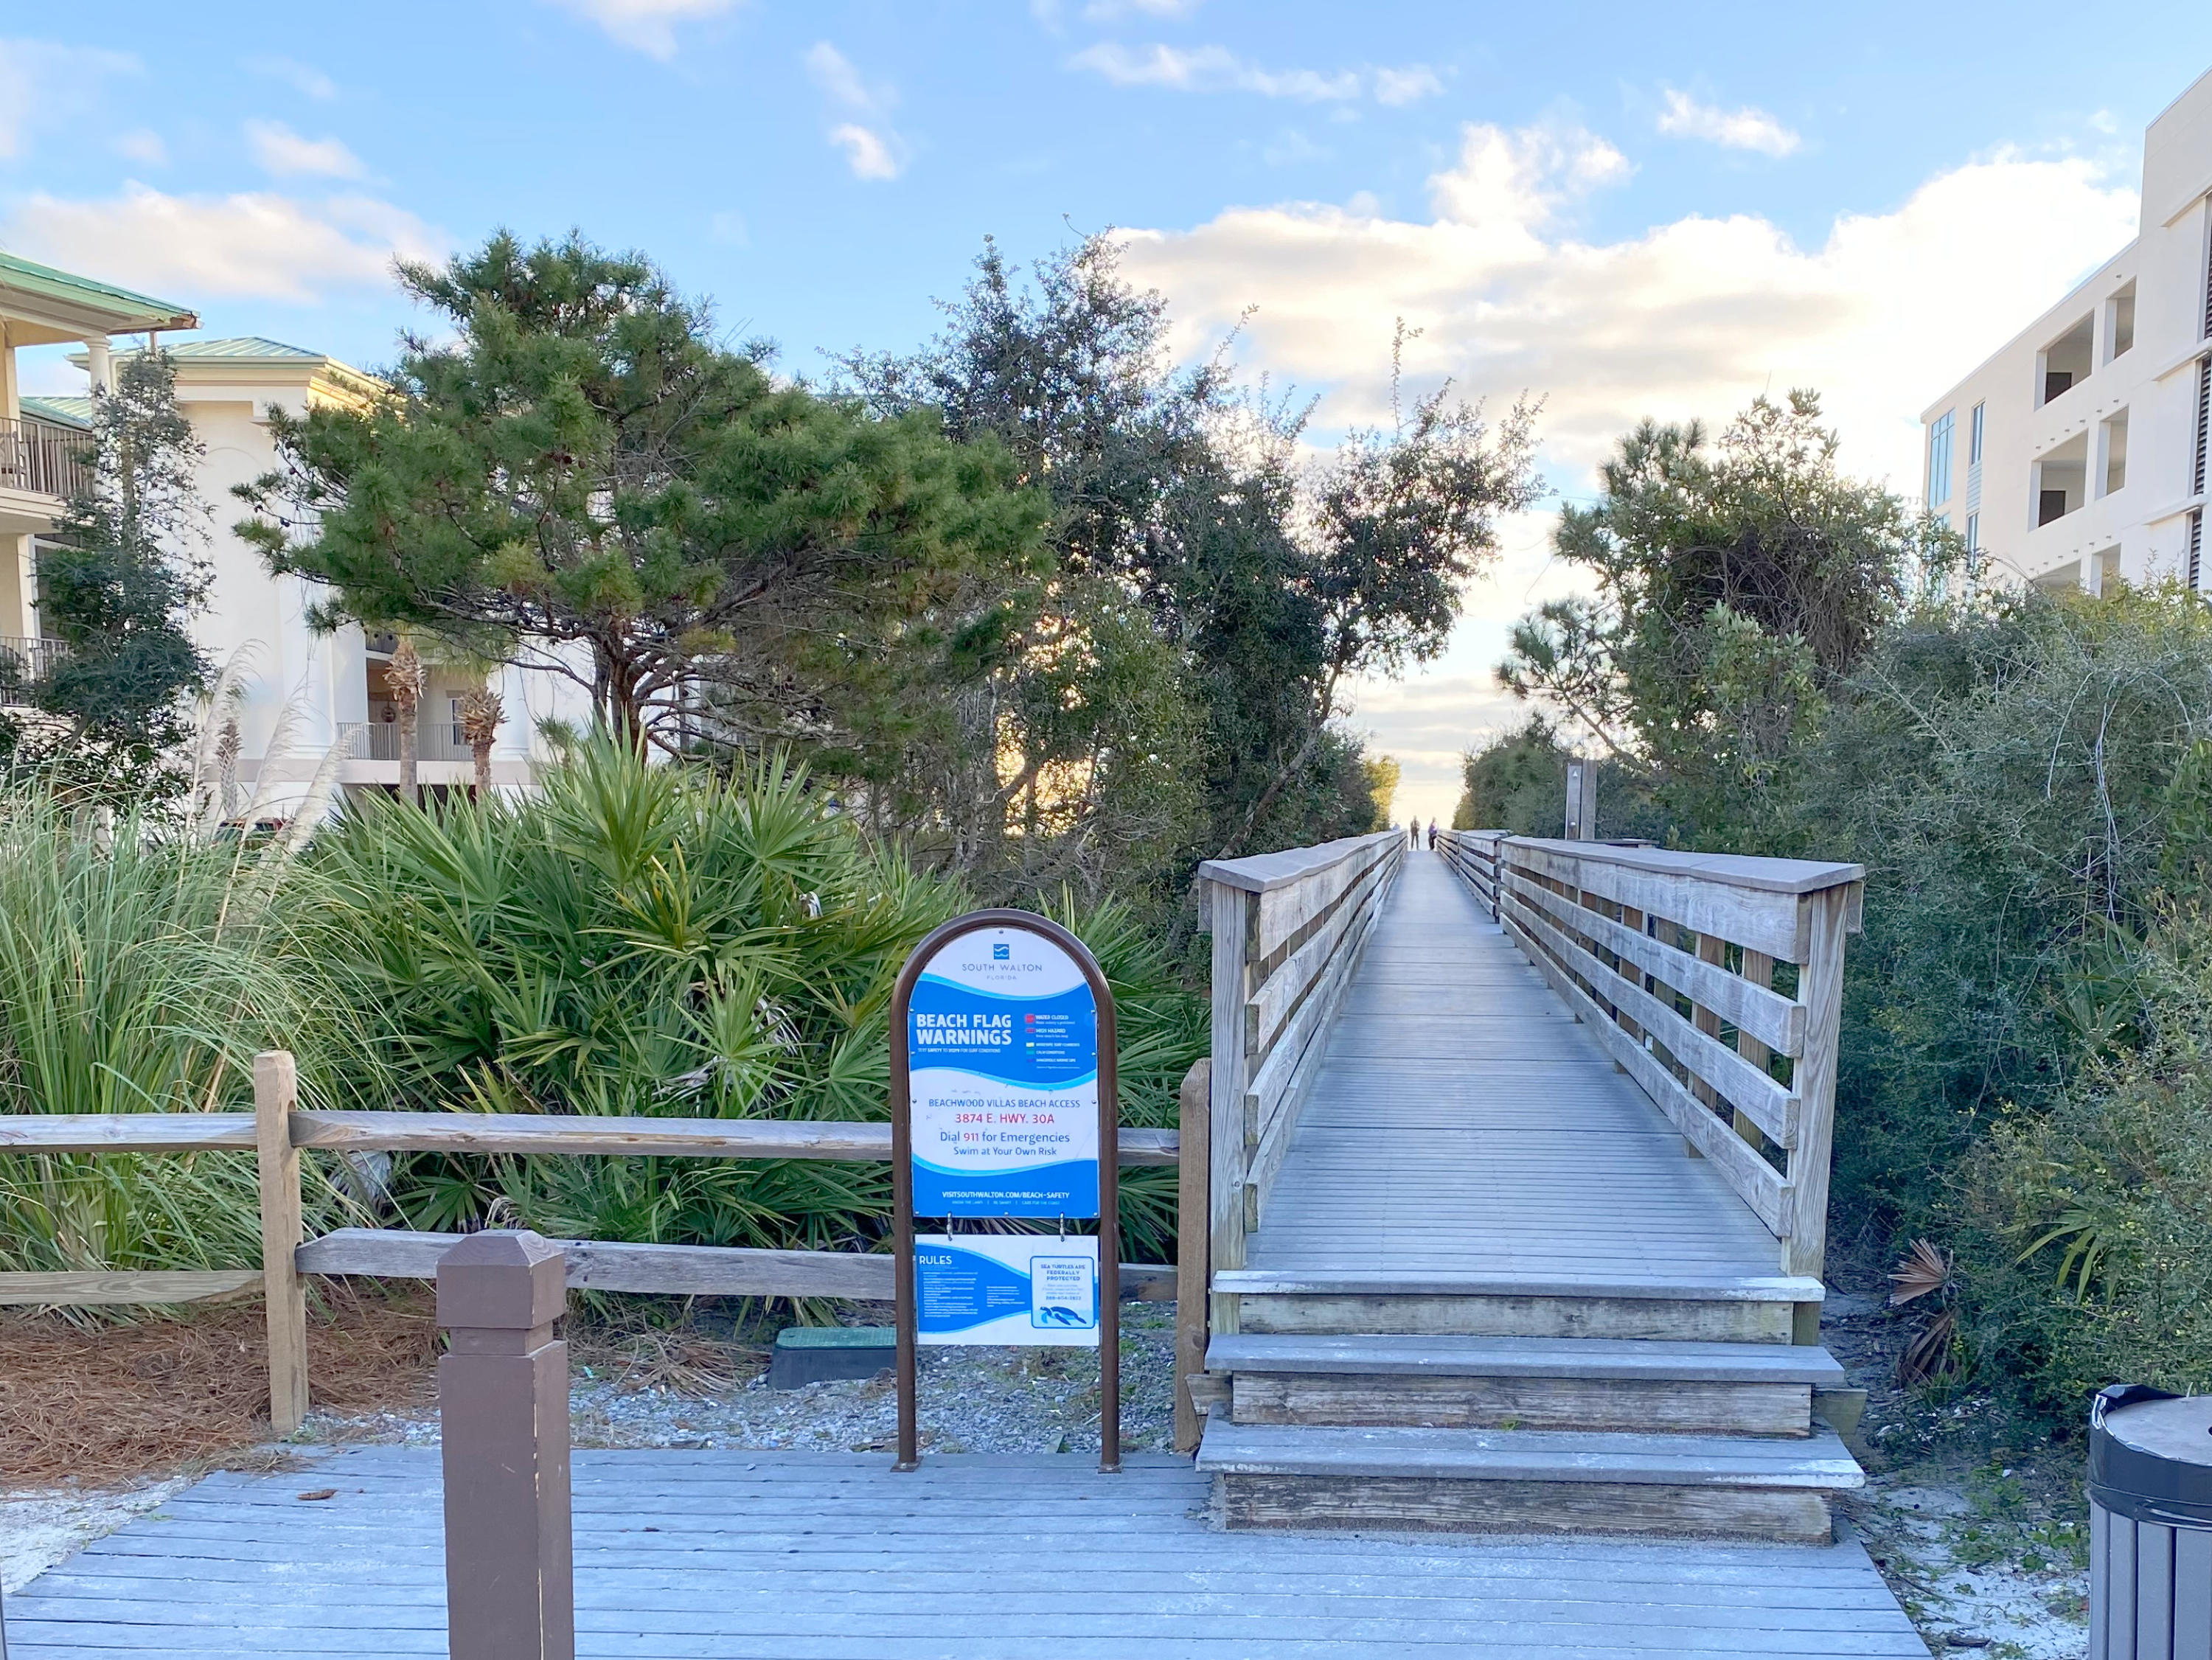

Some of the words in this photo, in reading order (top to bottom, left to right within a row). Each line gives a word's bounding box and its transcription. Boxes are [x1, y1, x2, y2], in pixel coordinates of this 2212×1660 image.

[961, 963, 995, 972] SOUTH
[1000, 963, 1043, 972] WALTON
[917, 1014, 967, 1028] BEACH
[973, 1014, 1012, 1028] FLAG
[916, 1029, 1012, 1046] WARNINGS
[928, 1099, 984, 1108] BEACHWOOD
[987, 1099, 1016, 1108] VILLAS
[1018, 1099, 1046, 1108] BEACH
[1048, 1100, 1080, 1108] ACCESS
[955, 1114, 983, 1123] 3874
[987, 1114, 996, 1123] E.
[1000, 1114, 1029, 1123] HWY.
[1032, 1114, 1054, 1124] 30A
[940, 1131, 960, 1142] Dial
[963, 1132, 979, 1142] 911
[982, 1131, 998, 1142] for
[1001, 1132, 1071, 1145] Emergencies
[953, 1146, 979, 1156] Swim
[981, 1147, 990, 1156] at
[992, 1147, 1013, 1156] Your
[1015, 1147, 1036, 1156] Own
[1038, 1147, 1057, 1156] Risk
[942, 1191, 1070, 1199] VISITSOUTHWALTON.COM/BEACH-SAFETY
[919, 1255, 953, 1265] RULES
